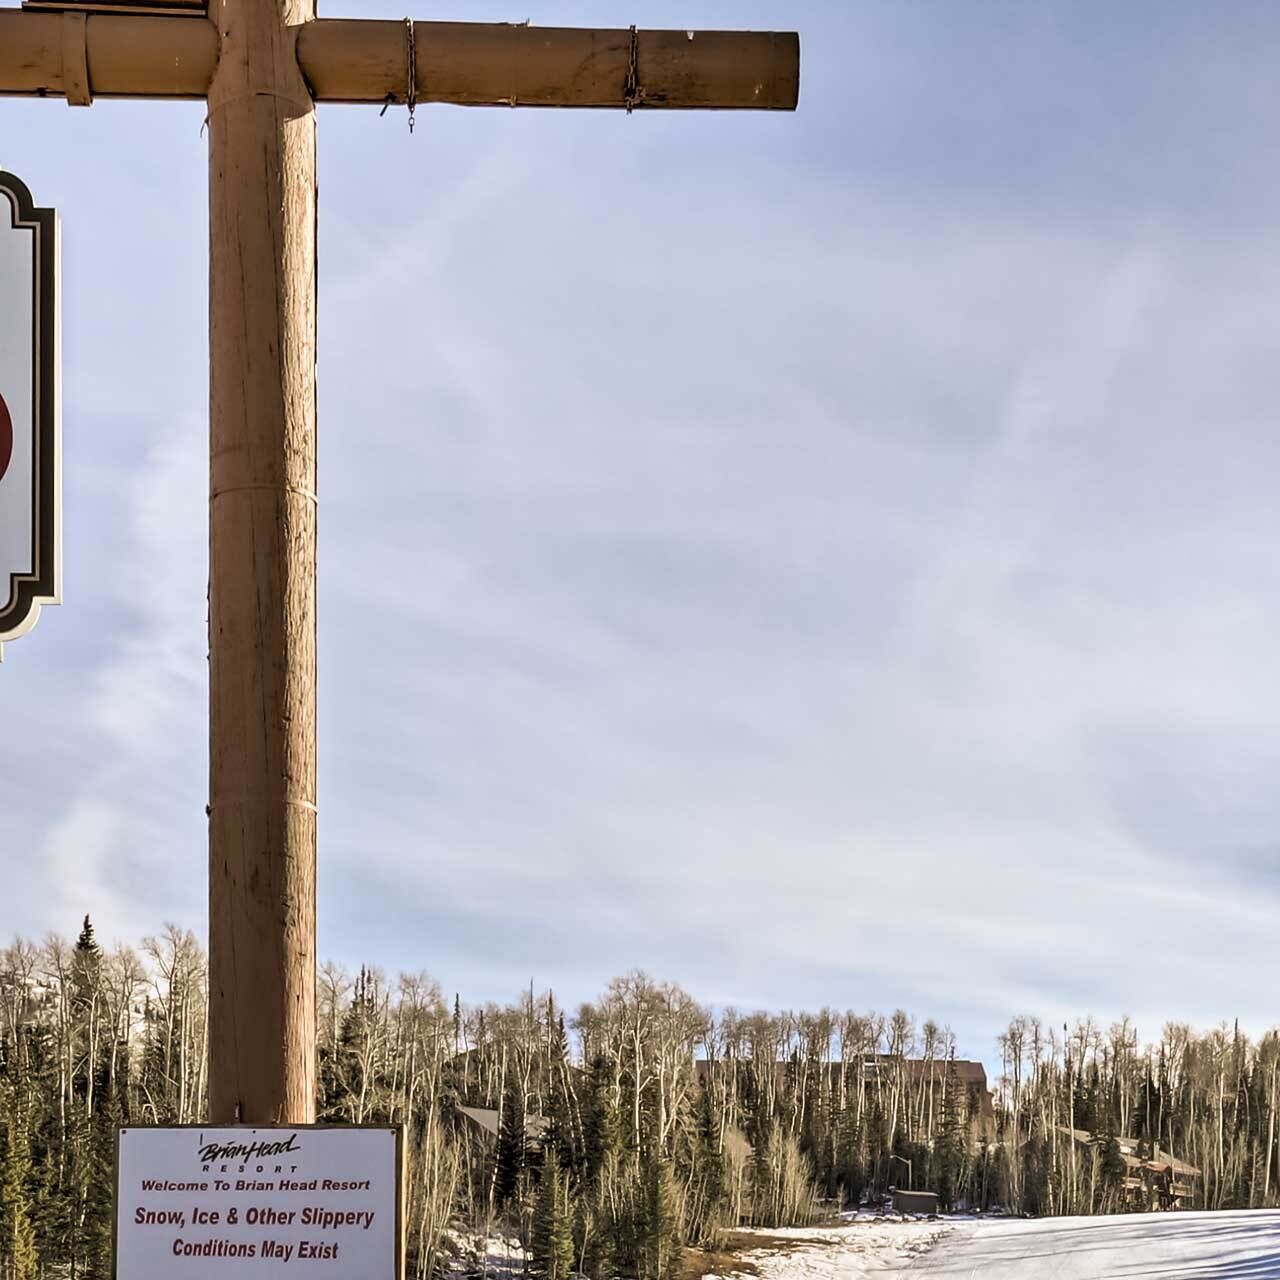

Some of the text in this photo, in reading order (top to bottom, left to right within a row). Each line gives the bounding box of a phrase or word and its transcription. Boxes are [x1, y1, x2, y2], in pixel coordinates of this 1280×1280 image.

[202, 1164, 298, 1173] RESORT
[141, 1179, 371, 1192] Welcome To Brian Head Resort
[134, 1207, 375, 1230] Snow, Ice & Other Slippery
[172, 1238, 340, 1263] Conditions May Exist
